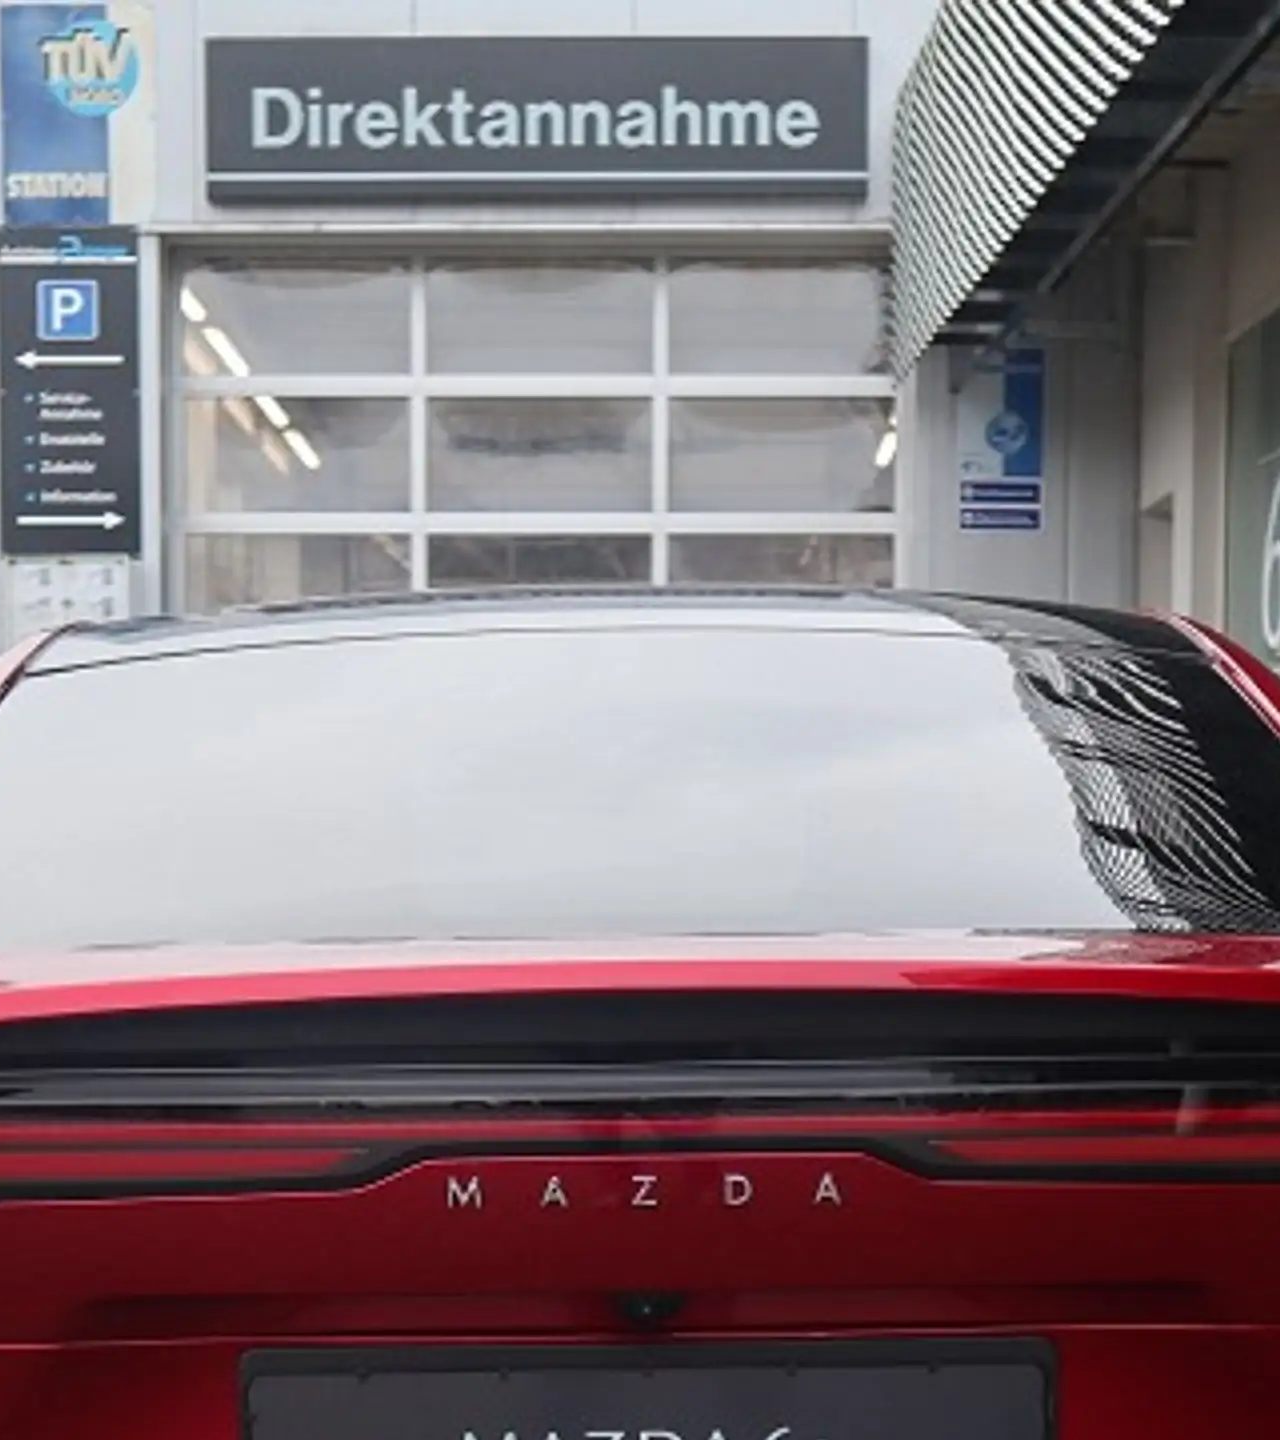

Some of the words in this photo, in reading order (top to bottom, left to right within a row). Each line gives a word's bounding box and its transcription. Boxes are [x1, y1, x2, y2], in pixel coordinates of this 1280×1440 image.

[37, 28, 130, 81] TÜV
[252, 86, 819, 149] Direktannahme
[7, 172, 107, 198] STATION
[52, 288, 84, 331] P
[446, 1172, 842, 1209] MAZDA
